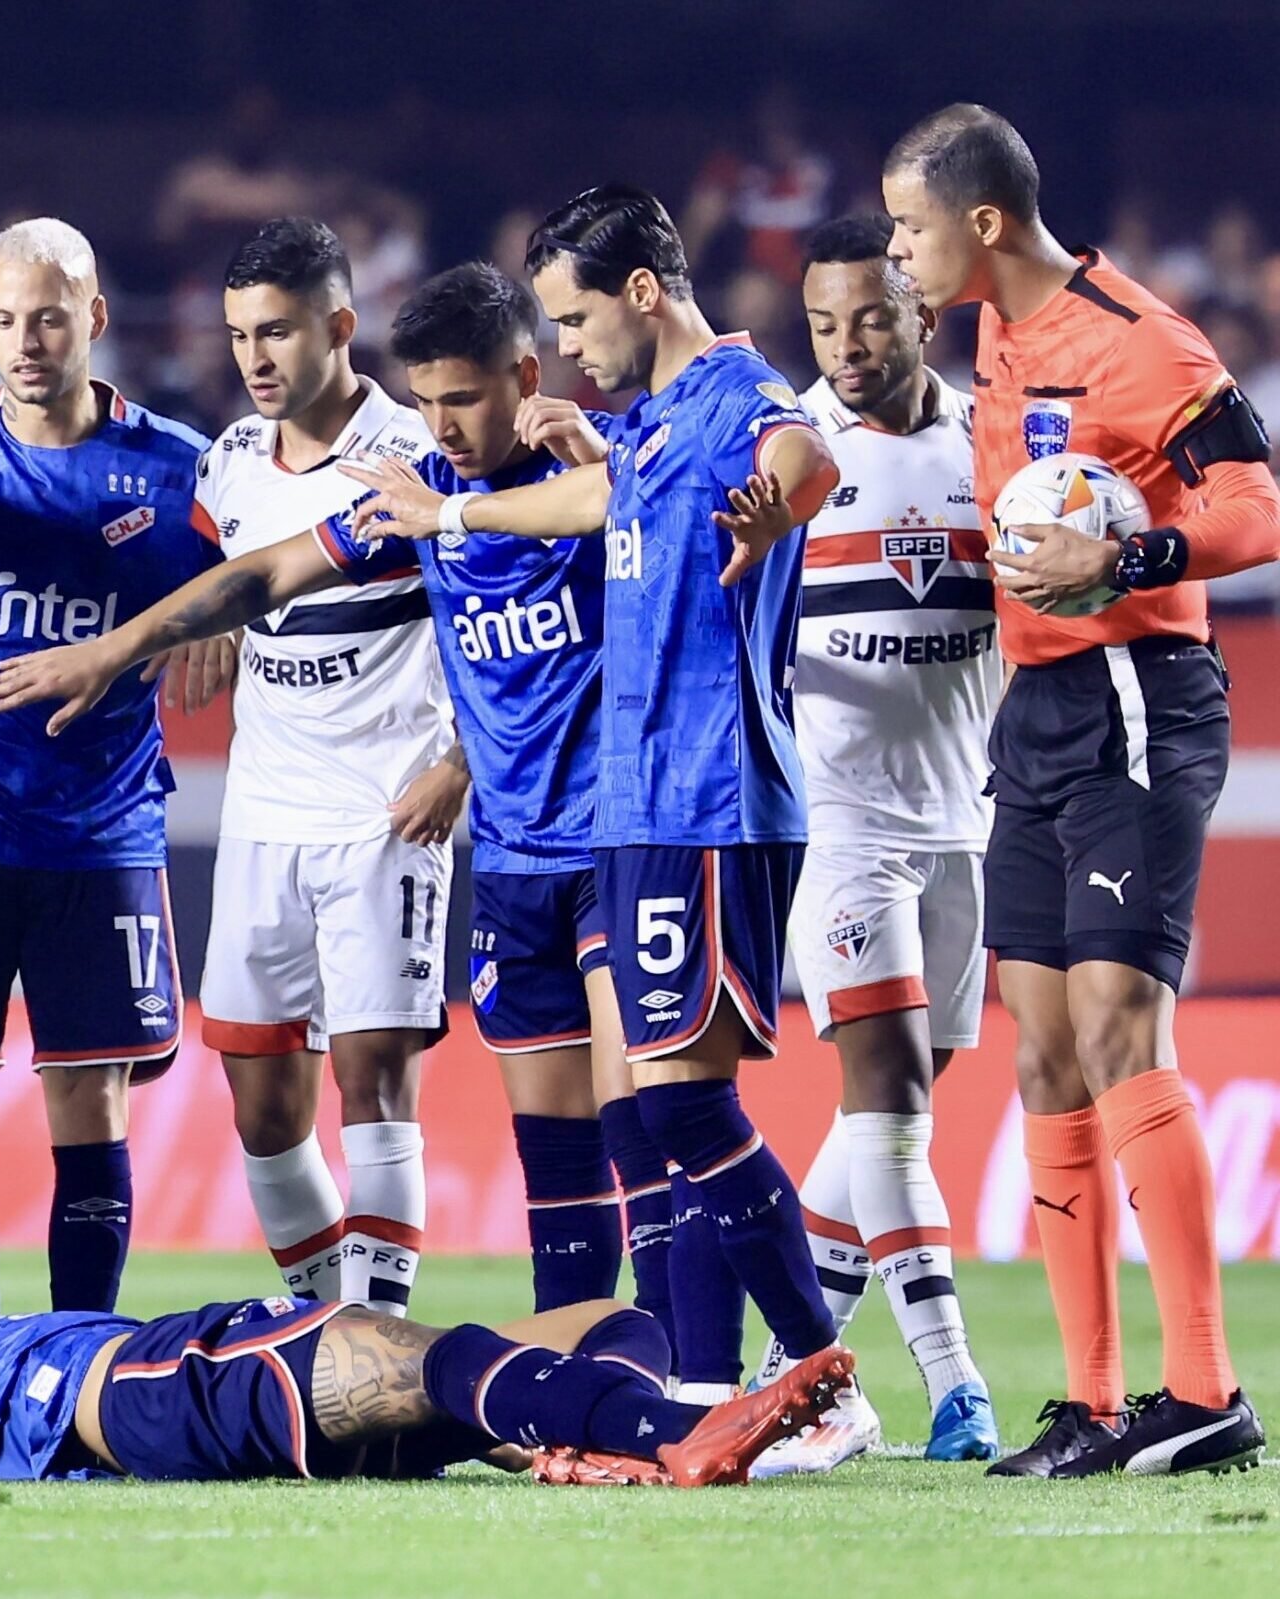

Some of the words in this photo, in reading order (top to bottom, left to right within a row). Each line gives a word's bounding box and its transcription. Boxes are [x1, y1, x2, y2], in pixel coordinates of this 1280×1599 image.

[887, 537, 943, 555] SPFC
[453, 583, 583, 663] antel
[826, 621, 997, 666] SUPERBET
[400, 874, 437, 945] 11
[637, 896, 686, 975] 5
[828, 923, 866, 945] SPFC
[113, 914, 161, 989] 17
[645, 1009, 682, 1023] umbro
